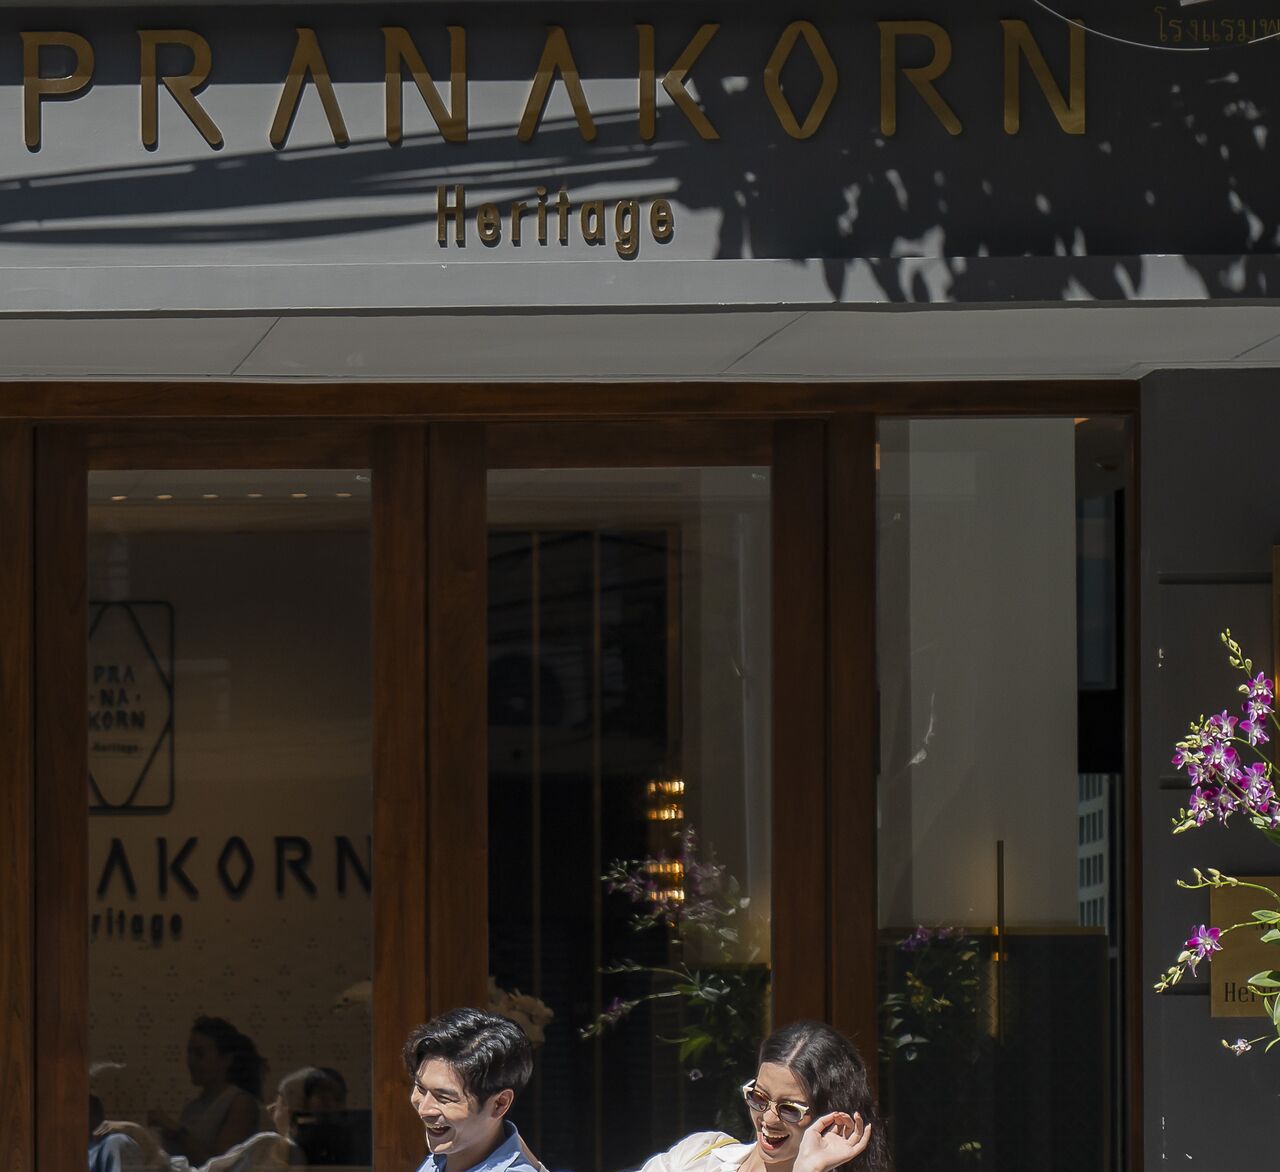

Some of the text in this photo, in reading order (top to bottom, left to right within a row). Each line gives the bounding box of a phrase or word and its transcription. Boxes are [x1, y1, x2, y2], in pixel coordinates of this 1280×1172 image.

[20, 18, 1087, 151] PRANAKORN
[436, 182, 676, 258] Heritage
[90, 908, 184, 947] ritage
